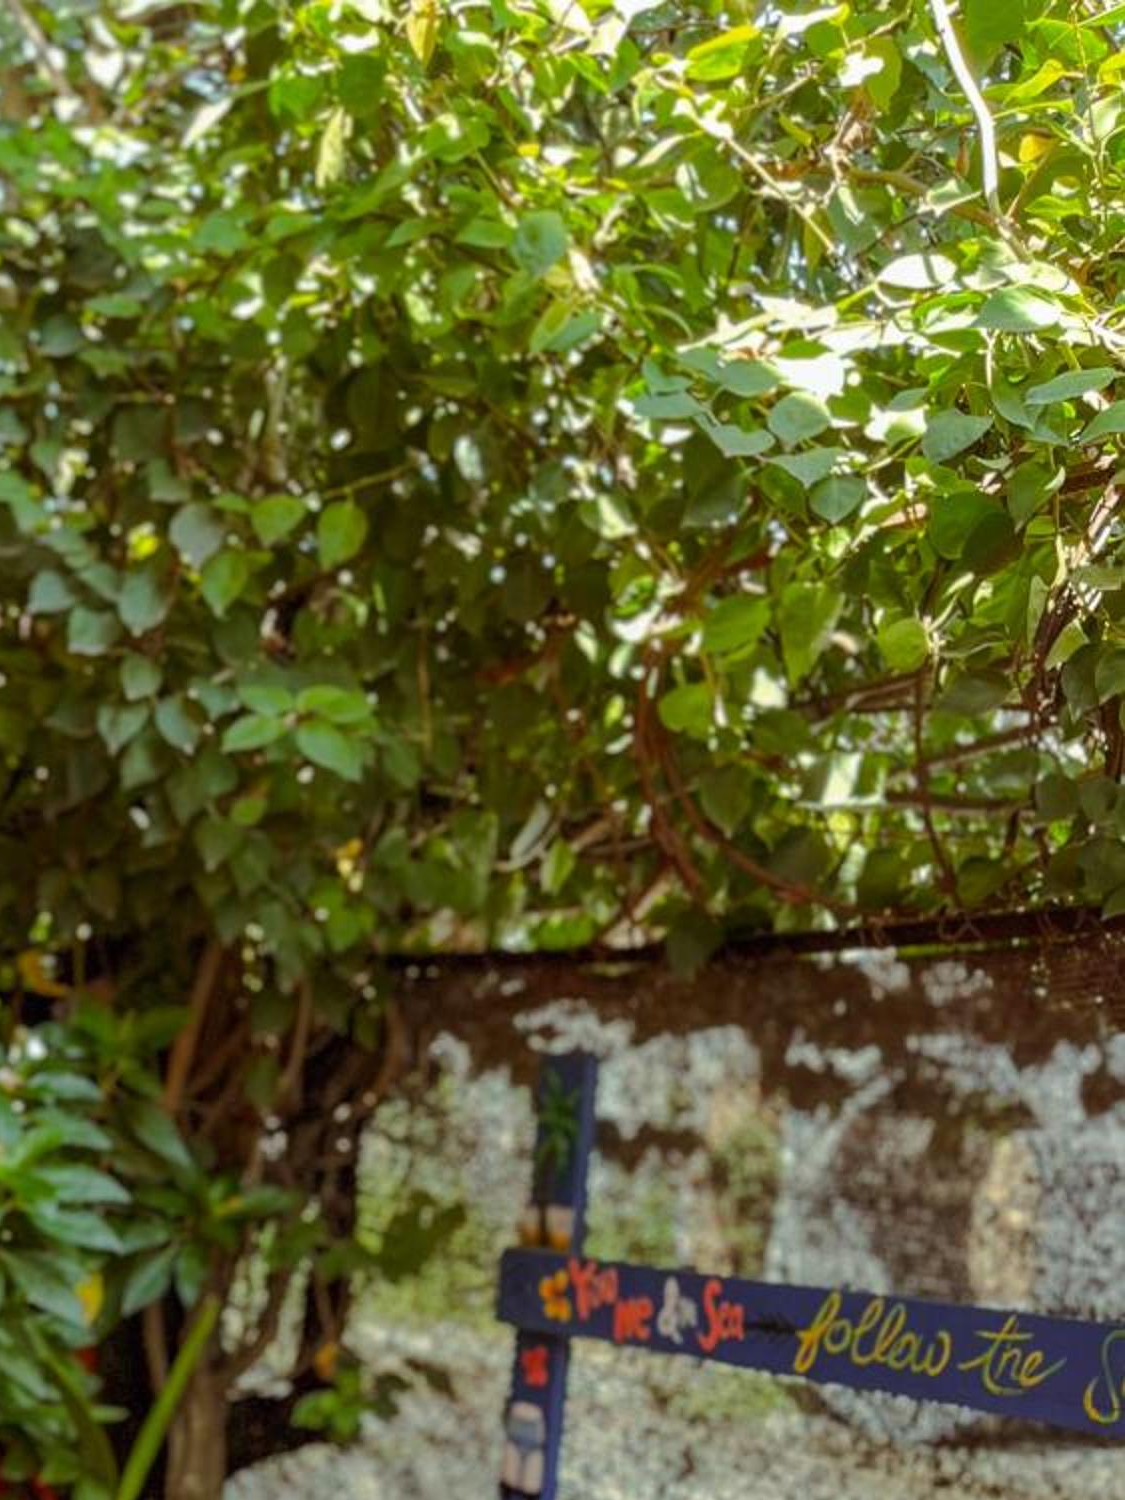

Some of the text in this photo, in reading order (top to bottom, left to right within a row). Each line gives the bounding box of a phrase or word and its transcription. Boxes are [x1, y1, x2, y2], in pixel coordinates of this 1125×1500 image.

[794, 1290, 1125, 1425] follow the S
